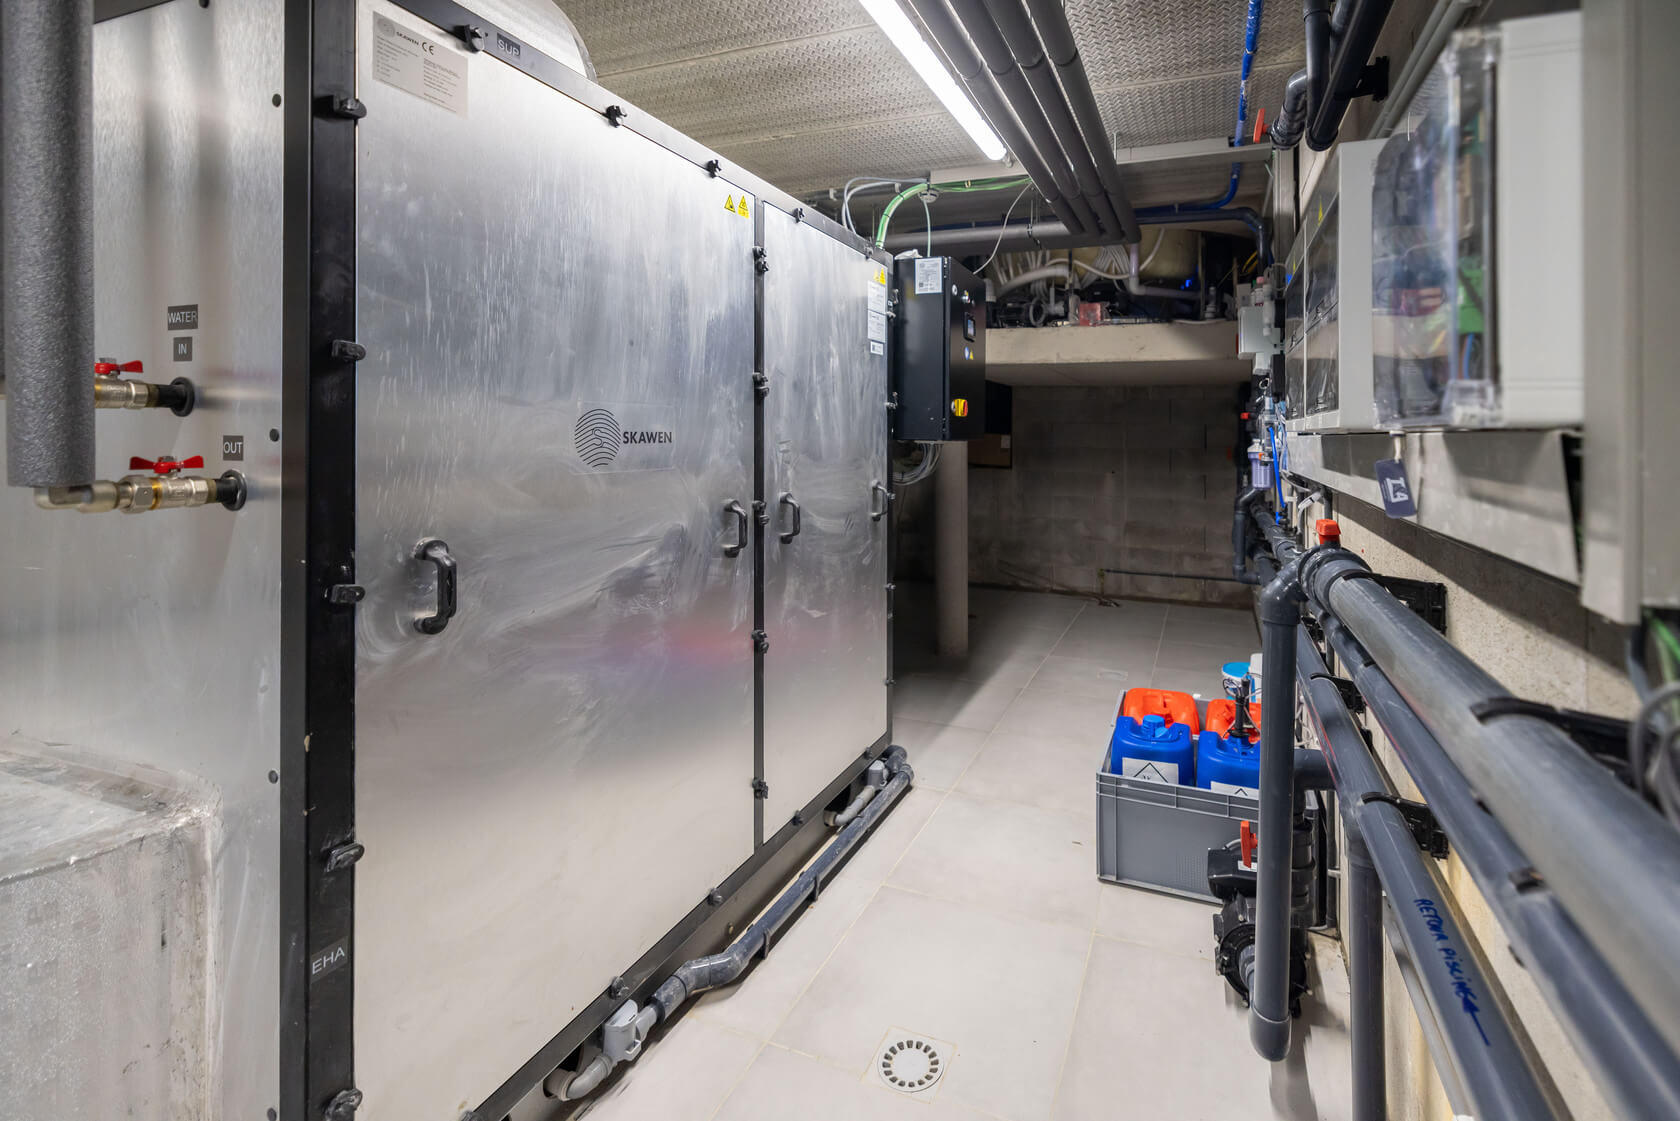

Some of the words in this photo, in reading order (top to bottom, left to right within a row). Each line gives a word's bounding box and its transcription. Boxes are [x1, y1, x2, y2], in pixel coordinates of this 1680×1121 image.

[497, 38, 521, 57] SUP
[167, 310, 198, 324] WATER
[178, 343, 188, 355] IN
[622, 431, 673, 445] SKAWEN
[223, 441, 243, 455] OUT
[312, 946, 346, 975] EHA
